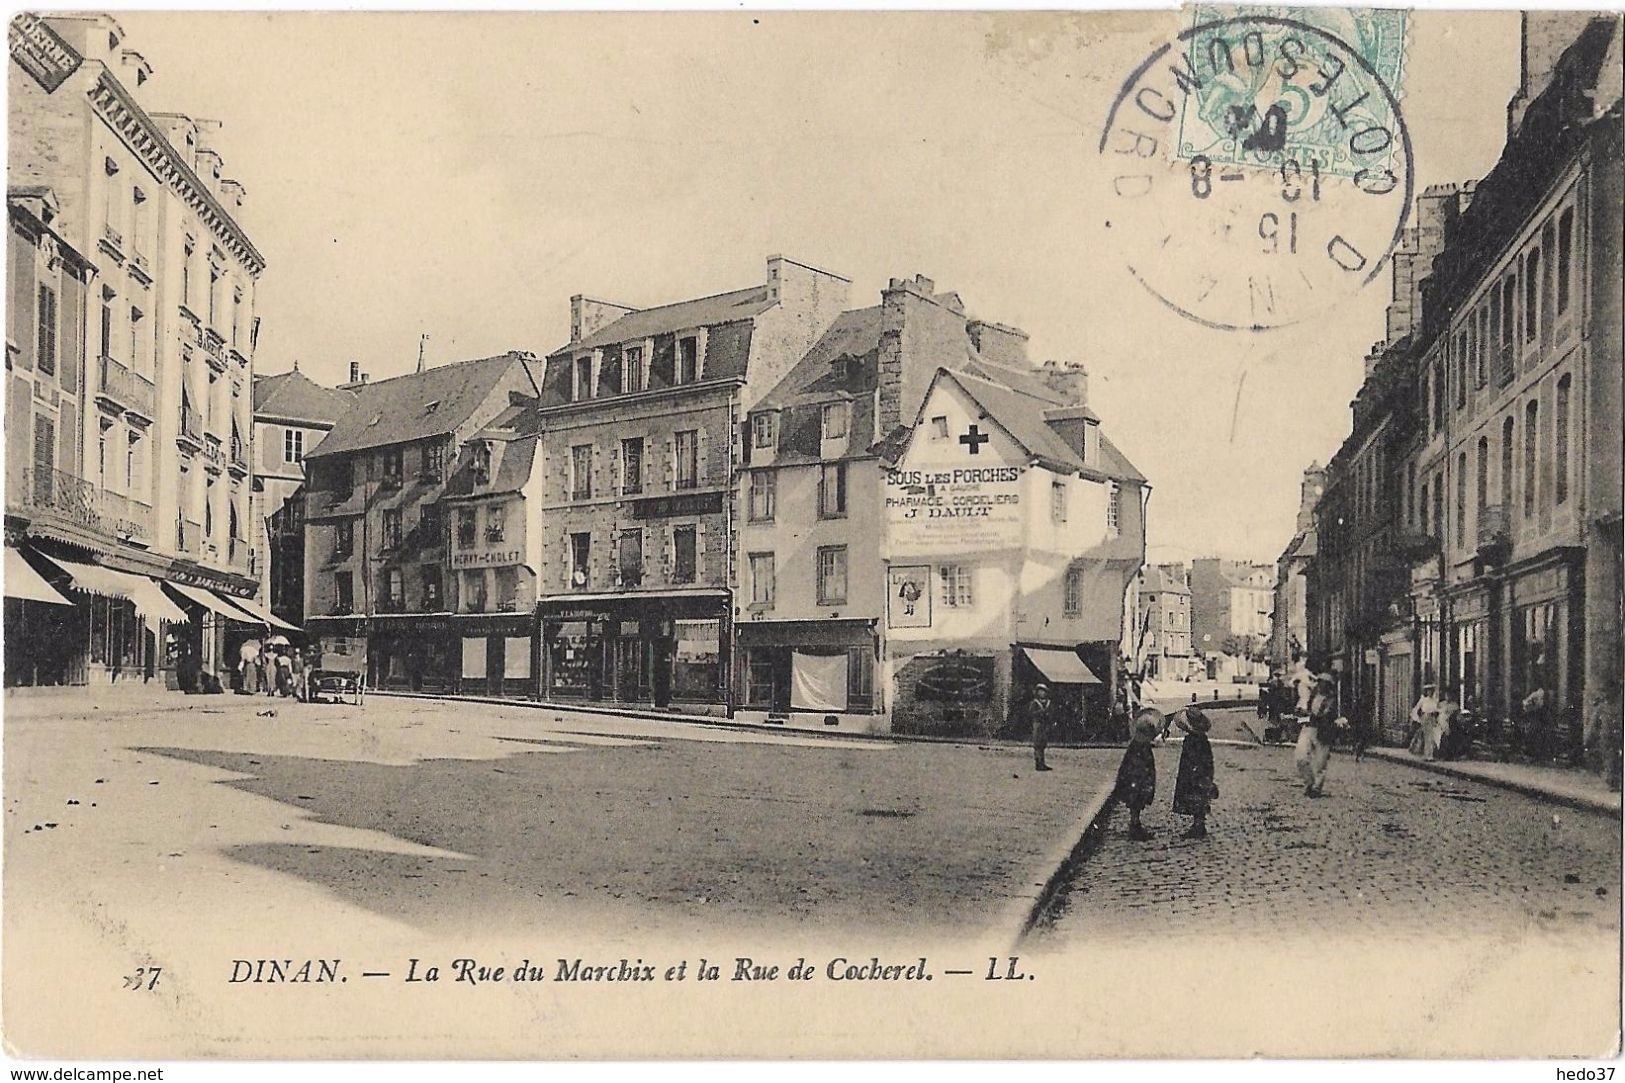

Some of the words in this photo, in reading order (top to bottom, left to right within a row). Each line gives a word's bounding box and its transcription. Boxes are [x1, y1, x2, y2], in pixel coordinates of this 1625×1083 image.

[9, 11, 75, 70] ODERNE
[887, 470, 922, 486] SOUS
[925, 473, 951, 485] LES
[953, 467, 1018, 484] PORCHES
[928, 506, 994, 519] DAULT
